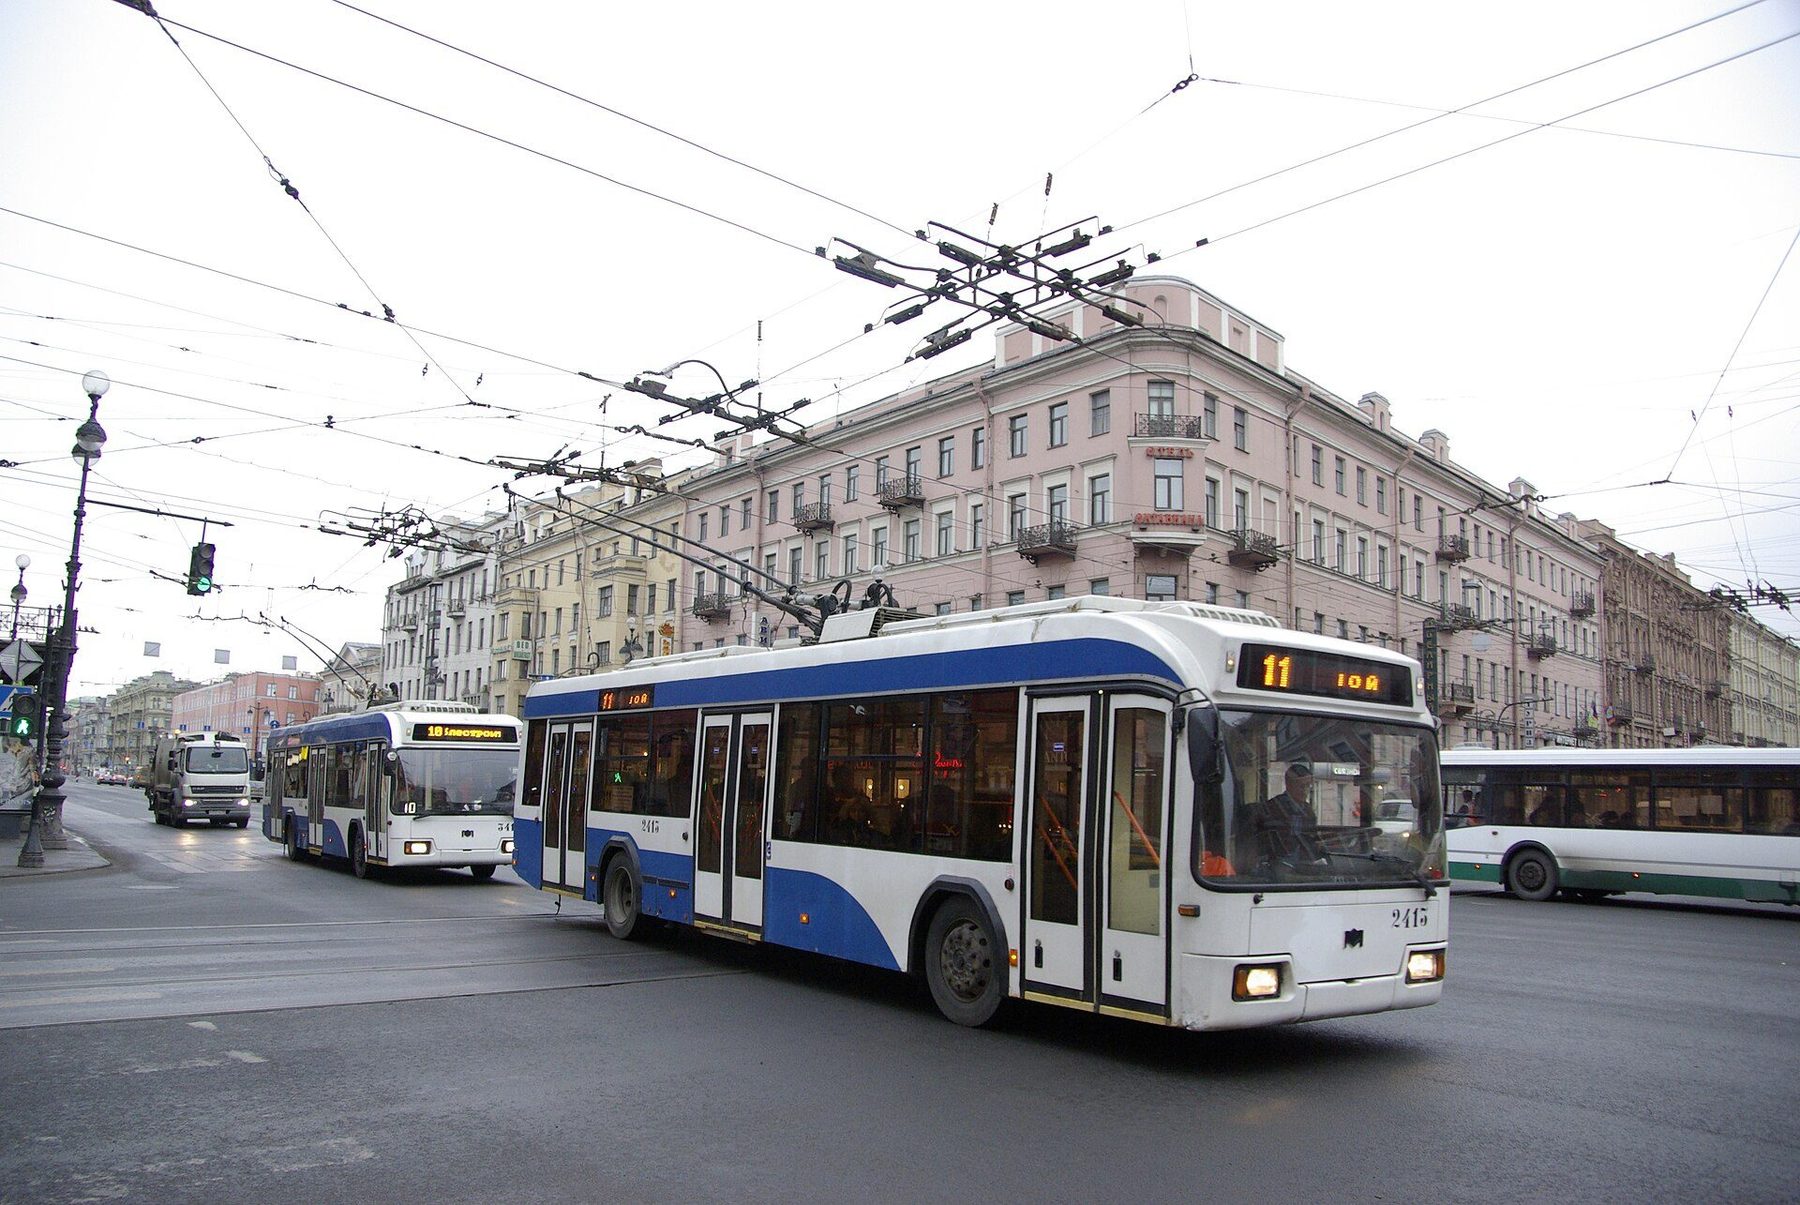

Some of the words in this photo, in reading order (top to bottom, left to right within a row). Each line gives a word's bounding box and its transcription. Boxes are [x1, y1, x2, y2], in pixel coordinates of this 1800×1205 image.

[1146, 447, 1194, 459] ОТЕЛЬ
[1263, 654, 1291, 688] 11
[602, 691, 614, 710] 11
[427, 725, 443, 737] 10
[404, 802, 417, 814] 10
[641, 819, 660, 834] 2415
[1391, 907, 1428, 929] 2415
